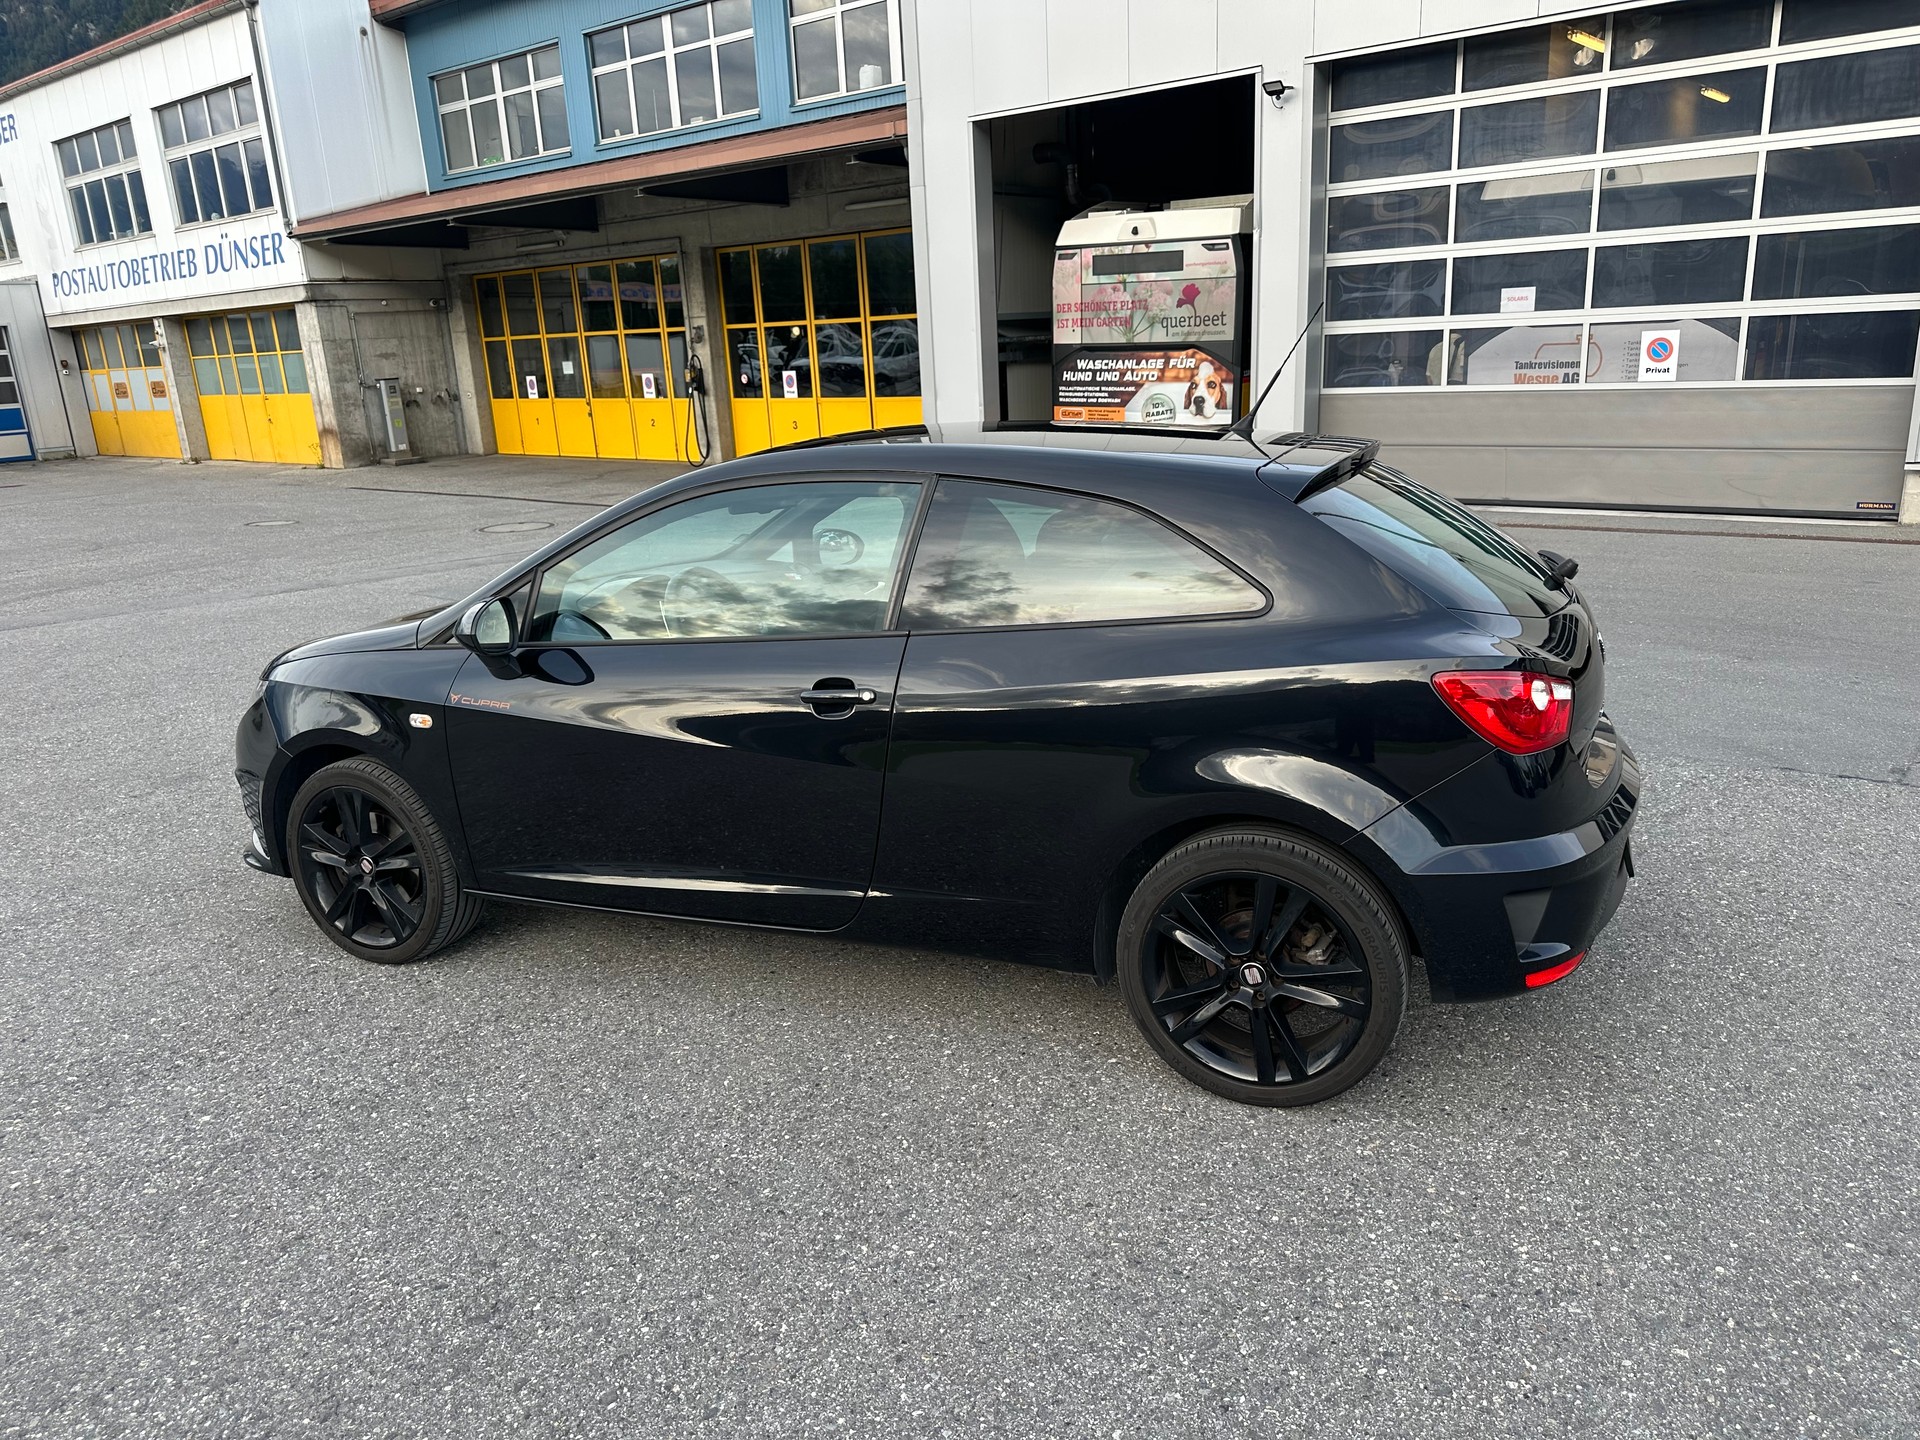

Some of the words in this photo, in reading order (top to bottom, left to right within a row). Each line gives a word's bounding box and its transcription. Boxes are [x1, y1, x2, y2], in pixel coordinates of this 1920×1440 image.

[52, 248, 198, 298] POSTAUTOBETRIEB
[204, 232, 285, 275] DÜNSER
[1057, 303, 1072, 313] DER
[1074, 300, 1118, 313] SCHÖNSTE
[1057, 318, 1070, 329] IST
[1071, 318, 1094, 328] MEIN
[1096, 316, 1131, 328] GARTEN
[1161, 310, 1227, 337] querbeet
[1076, 358, 1165, 370] WASCHANLAGE
[1168, 355, 1196, 369] FÜR
[1514, 359, 1580, 370] Tankrevisionen
[1062, 370, 1093, 381] HUND
[1096, 371, 1120, 381] UND
[1123, 370, 1159, 381] AUTO
[1645, 366, 1670, 374] Privat
[1561, 371, 1580, 384] AG
[1152, 401, 1165, 409] 10%
[1145, 408, 1174, 418] RABATT
[536, 417, 540, 425] 1
[651, 418, 656, 427] 2
[792, 420, 798, 430] 3
[461, 697, 511, 709] CUPRA
[1361, 926, 1389, 993] BRAVURIS
